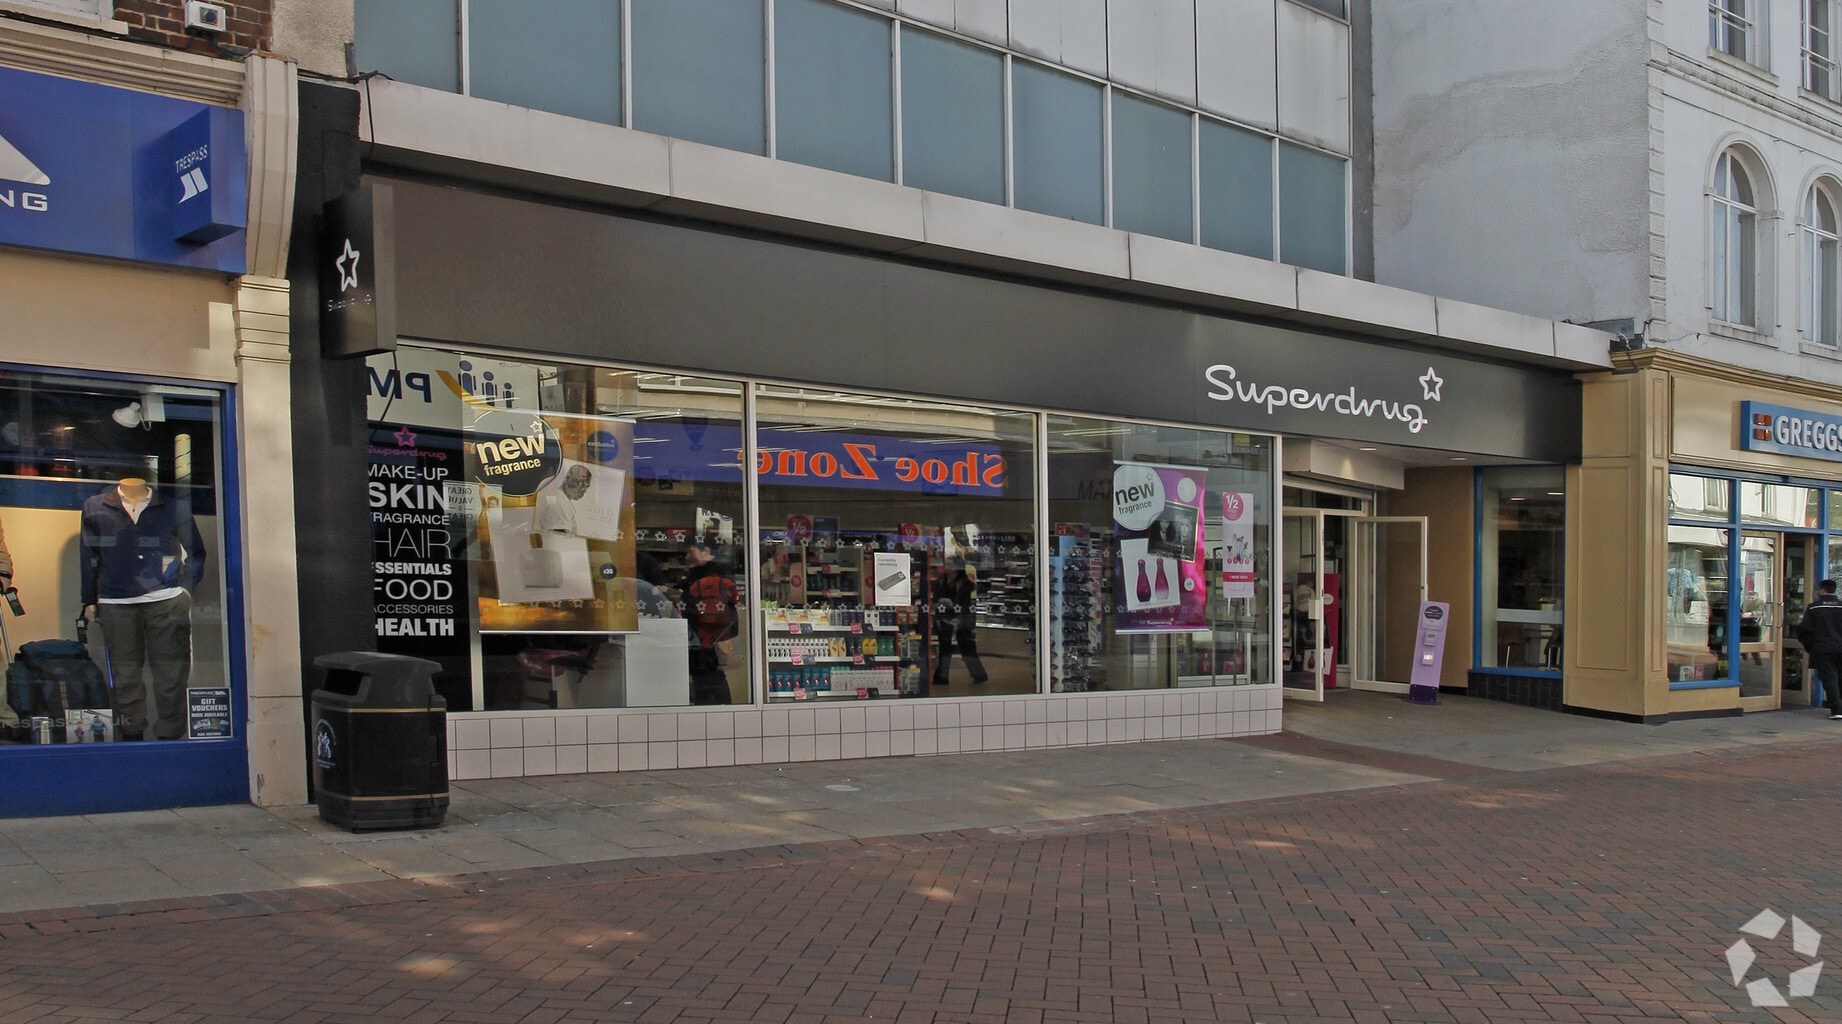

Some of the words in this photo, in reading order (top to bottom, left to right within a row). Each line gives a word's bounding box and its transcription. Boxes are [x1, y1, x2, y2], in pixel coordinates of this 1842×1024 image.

[175, 144, 208, 173] TRESPASS
[1205, 364, 1428, 433] Superdrug
[476, 433, 545, 464] new
[368, 464, 448, 480] MAKE-UP
[483, 457, 541, 476] fragrance
[368, 482, 450, 510] SKIN
[1115, 481, 1155, 506] new
[1118, 500, 1152, 515] fragrance
[371, 512, 450, 526] RAGRANCE
[372, 562, 452, 575] SSENTIALS
[375, 604, 454, 614] CCESSORIES
[191, 704, 228, 712] VOUCHERS
